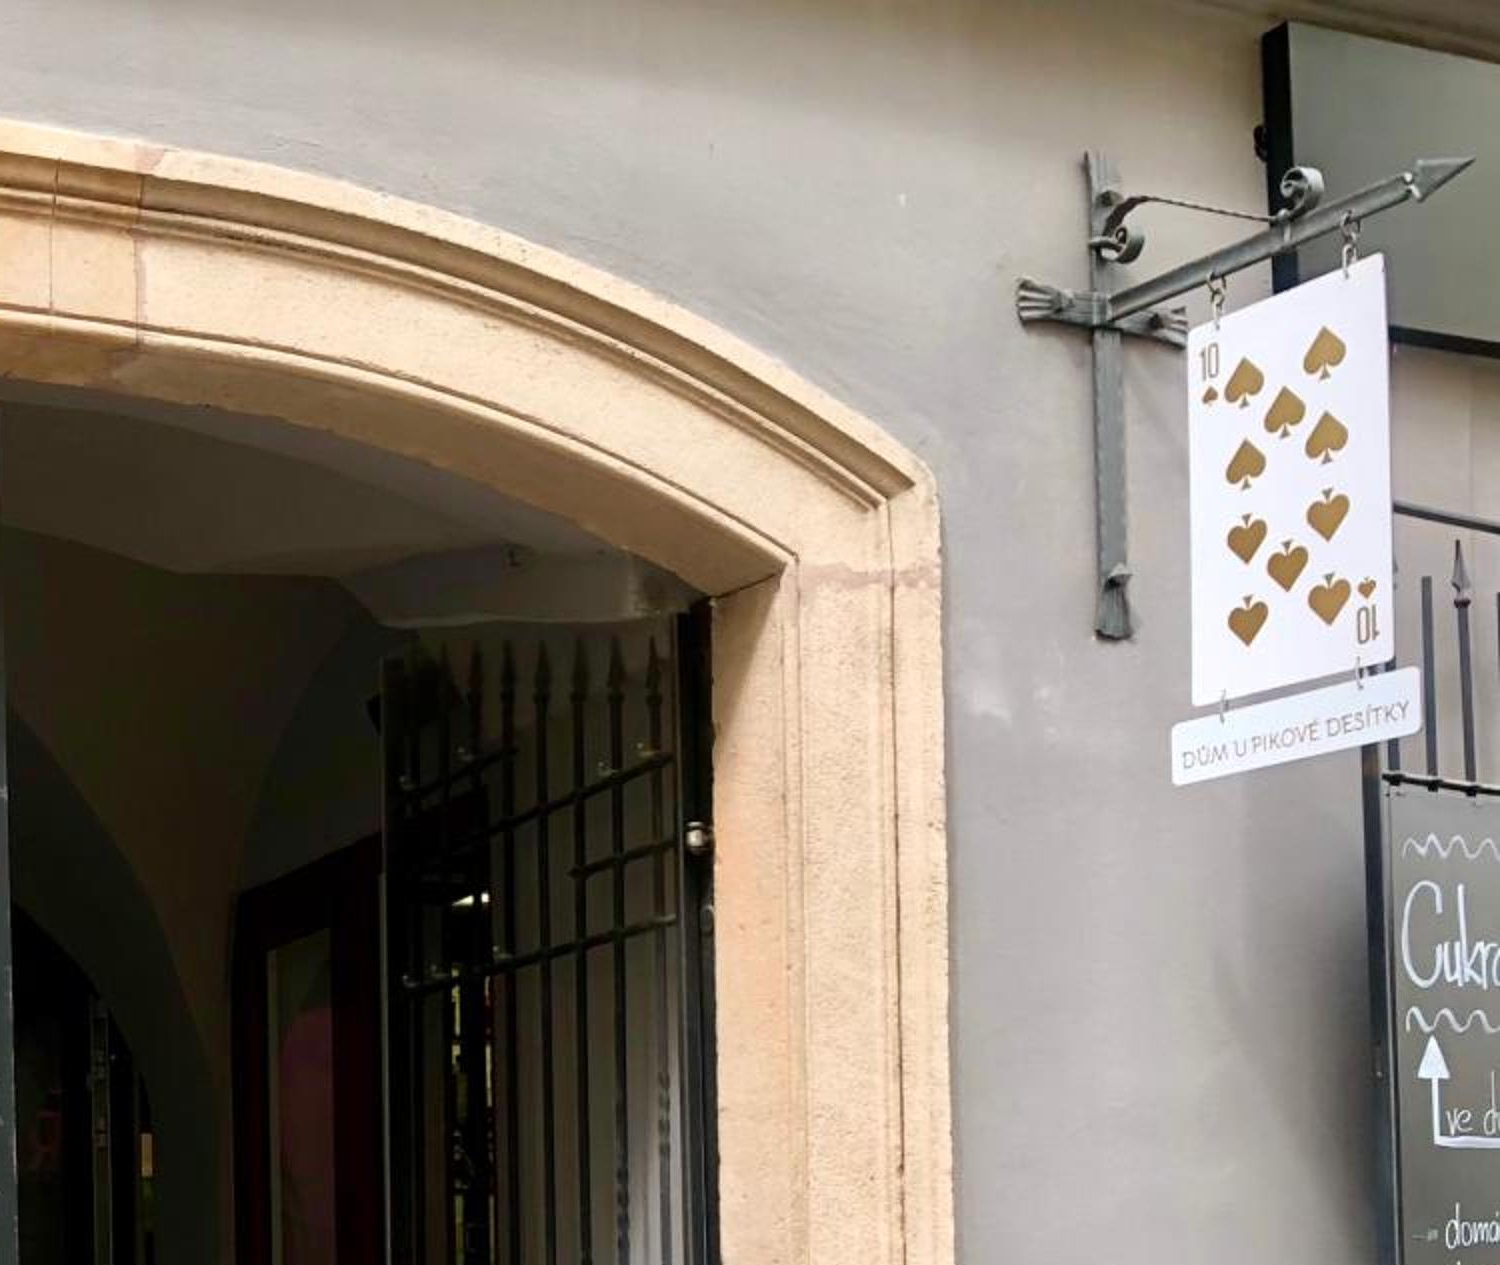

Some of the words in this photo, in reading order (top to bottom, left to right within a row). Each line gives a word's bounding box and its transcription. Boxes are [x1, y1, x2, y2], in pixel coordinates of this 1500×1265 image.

[1199, 342, 1220, 381] 10
[1357, 604, 1380, 644] 10
[1182, 744, 1229, 770] DŮM
[1233, 739, 1248, 758] U
[1251, 720, 1318, 753] PIKOVÉ
[1326, 700, 1410, 738] DESÍTKY
